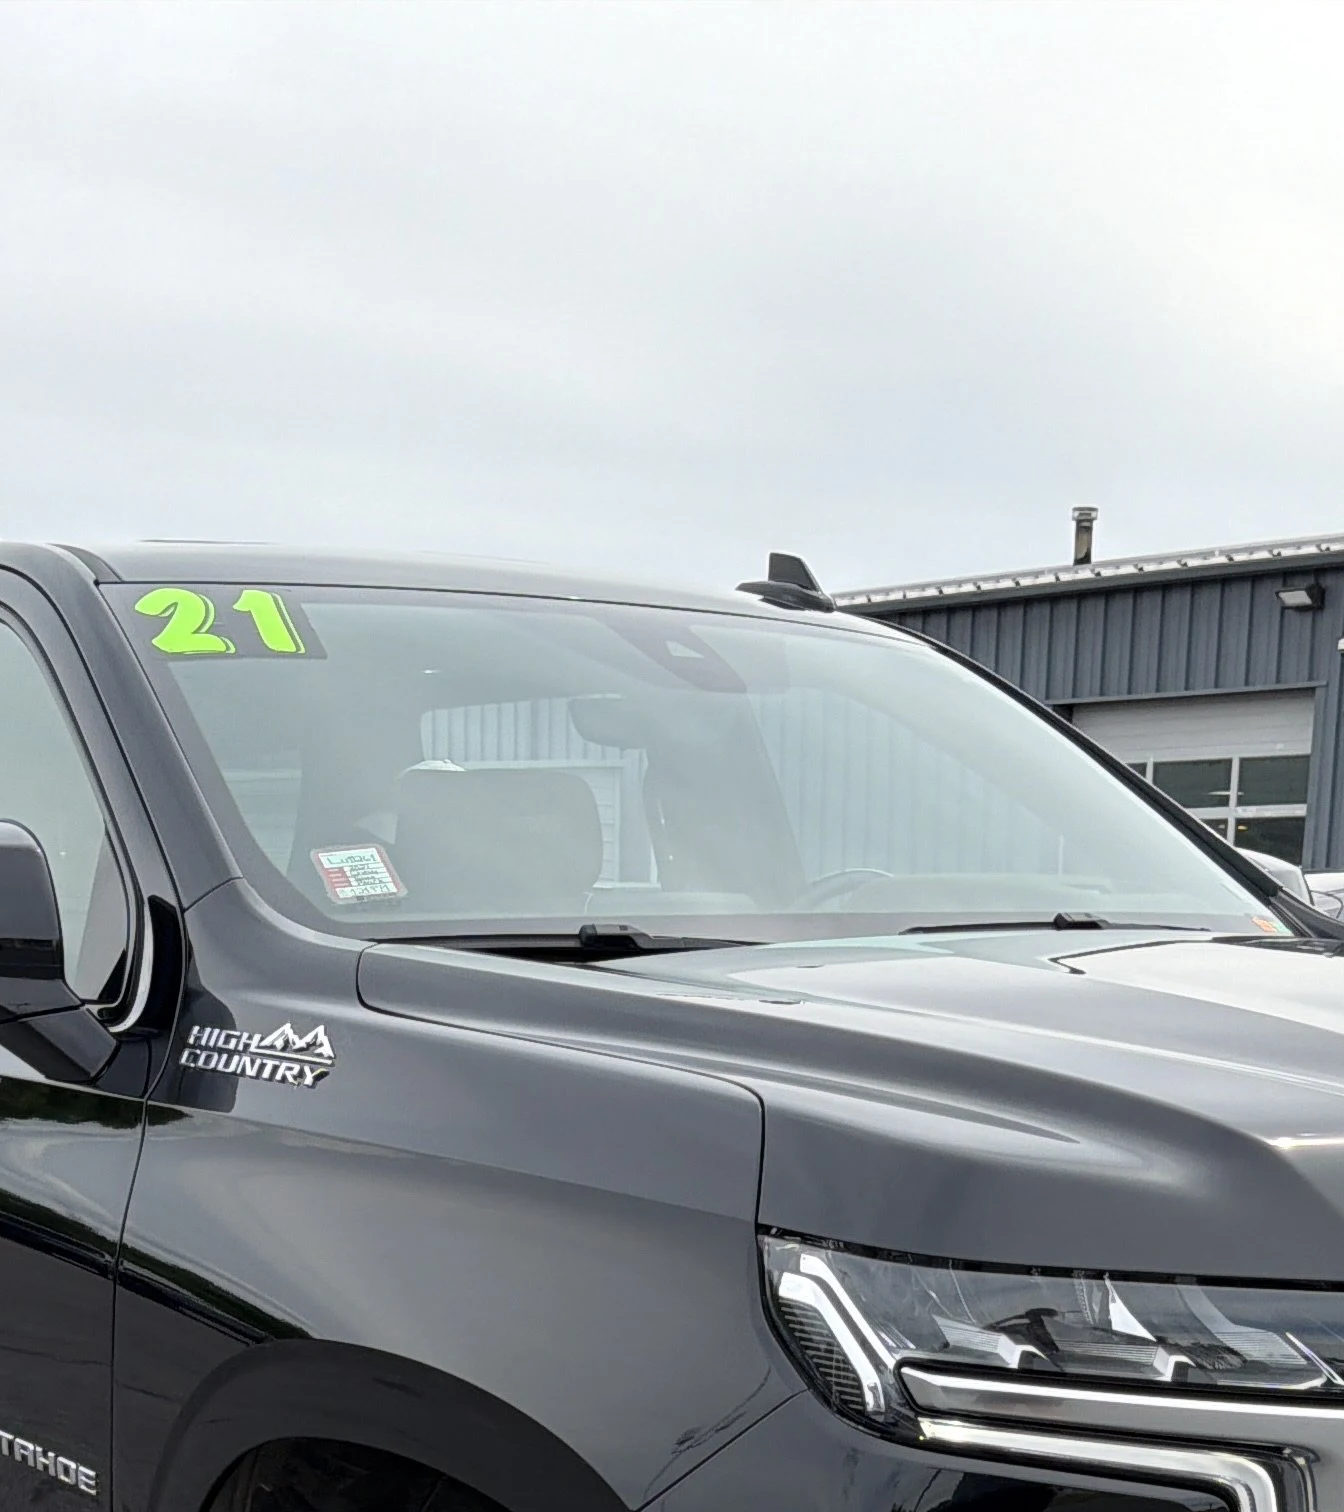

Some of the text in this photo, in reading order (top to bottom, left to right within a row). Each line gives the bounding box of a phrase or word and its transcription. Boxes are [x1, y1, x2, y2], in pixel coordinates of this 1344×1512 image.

[134, 587, 306, 655] 21
[187, 1024, 262, 1051] HIGH
[179, 1047, 330, 1087] COUNTRY
